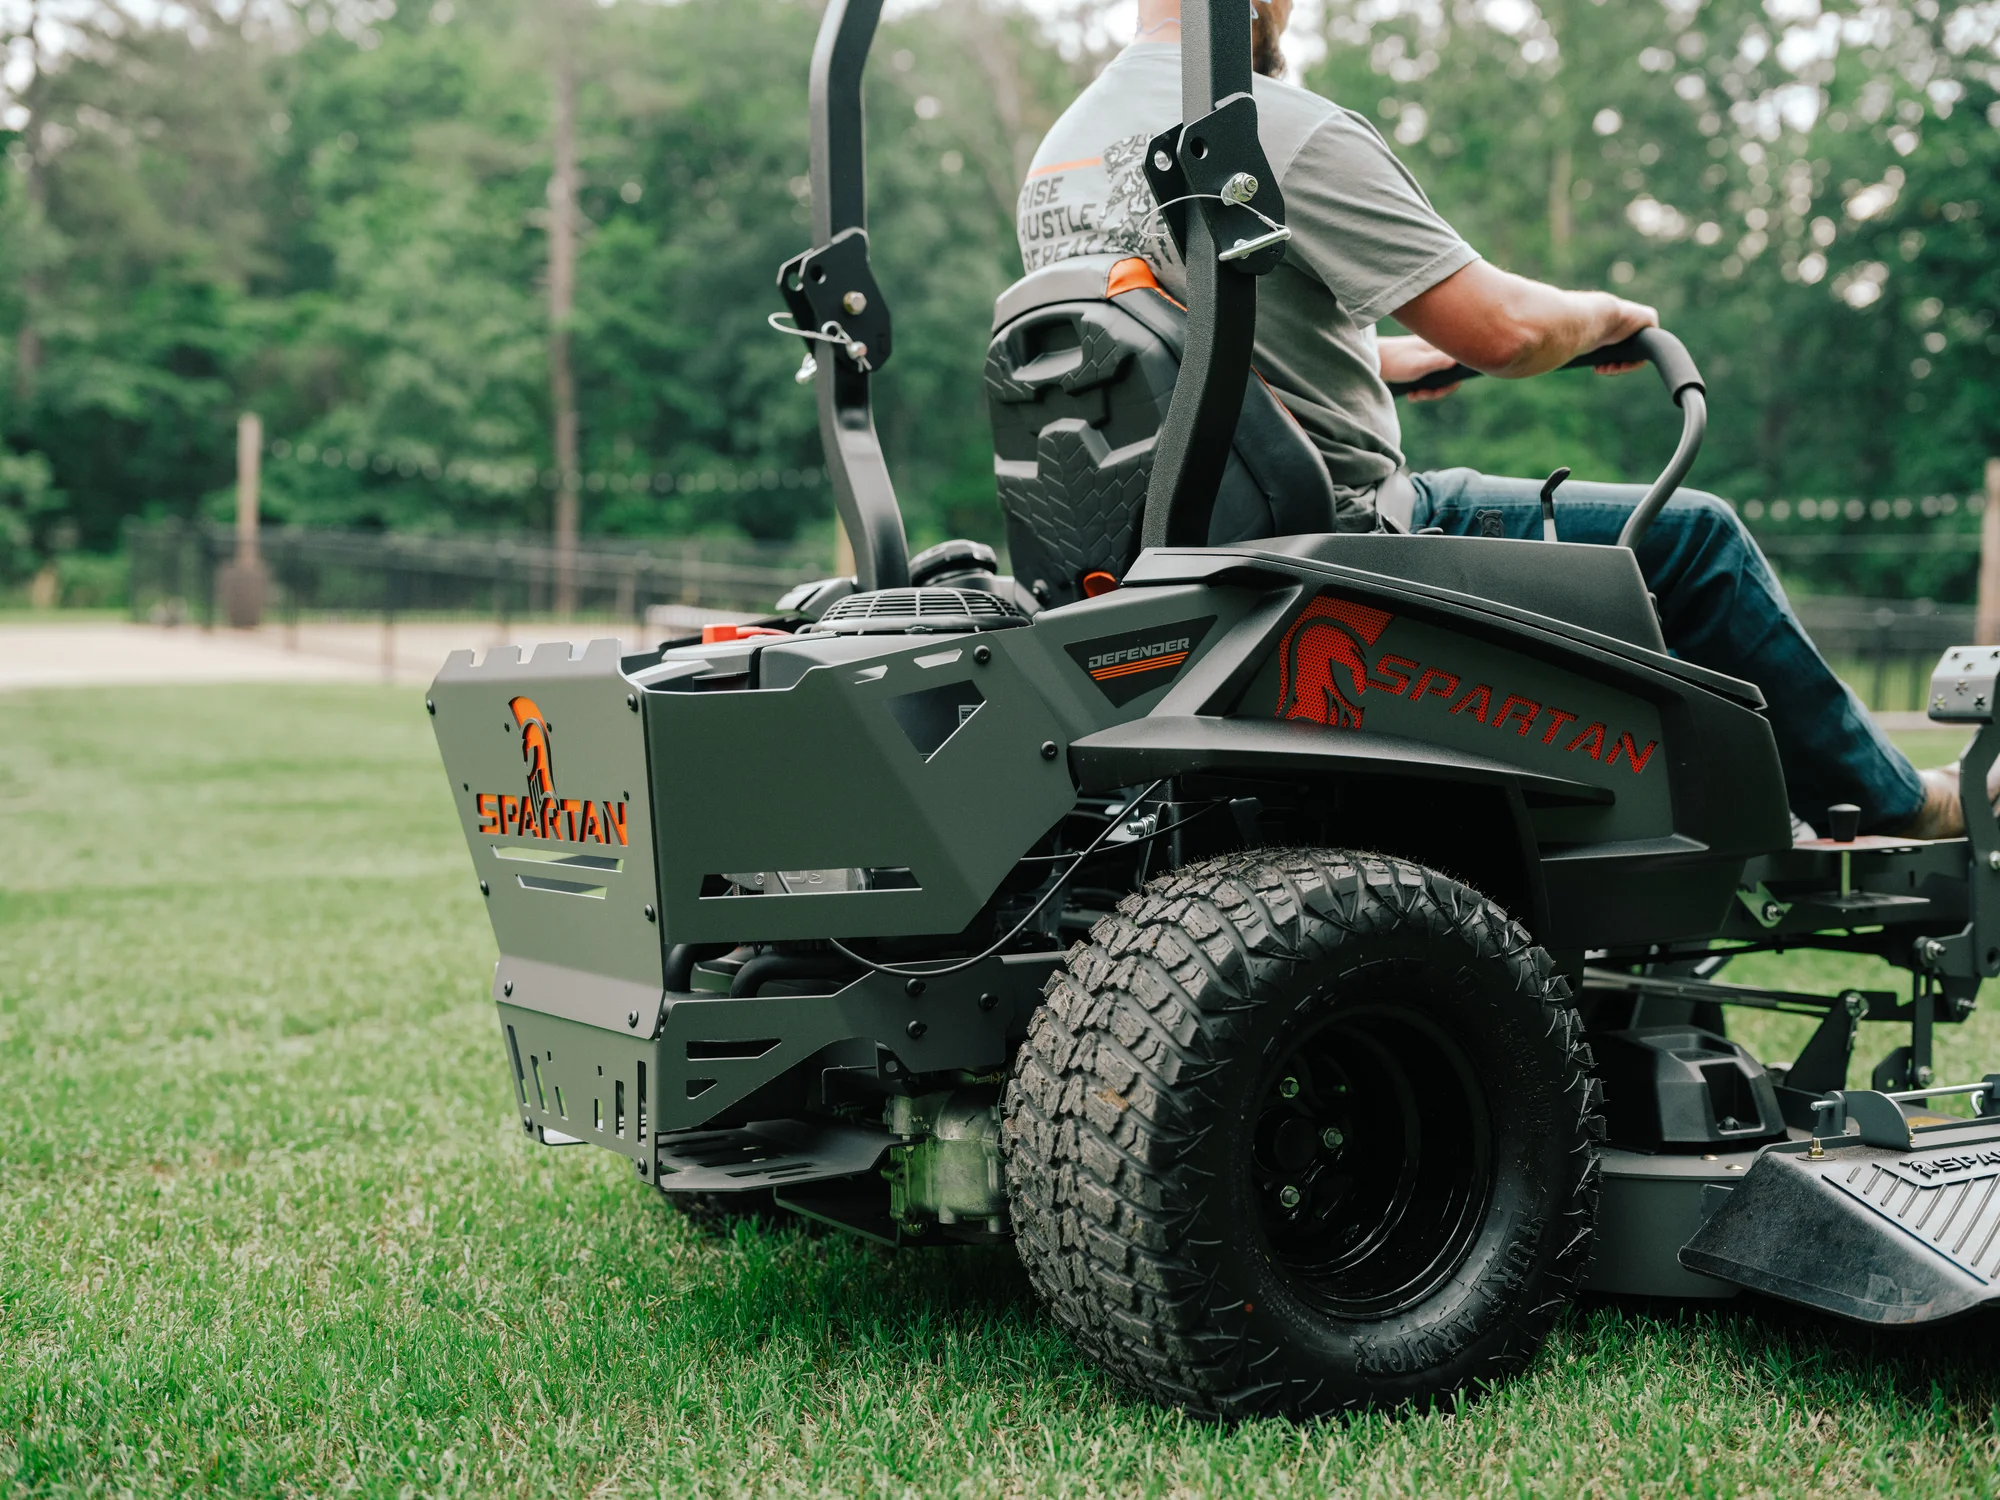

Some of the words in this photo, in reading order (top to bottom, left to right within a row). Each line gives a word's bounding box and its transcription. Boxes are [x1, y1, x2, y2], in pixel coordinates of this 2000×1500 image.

[1088, 637, 1190, 669] DEFENDER
[1367, 652, 1659, 774] SPARTAN
[476, 793, 629, 847] SPARTAN
